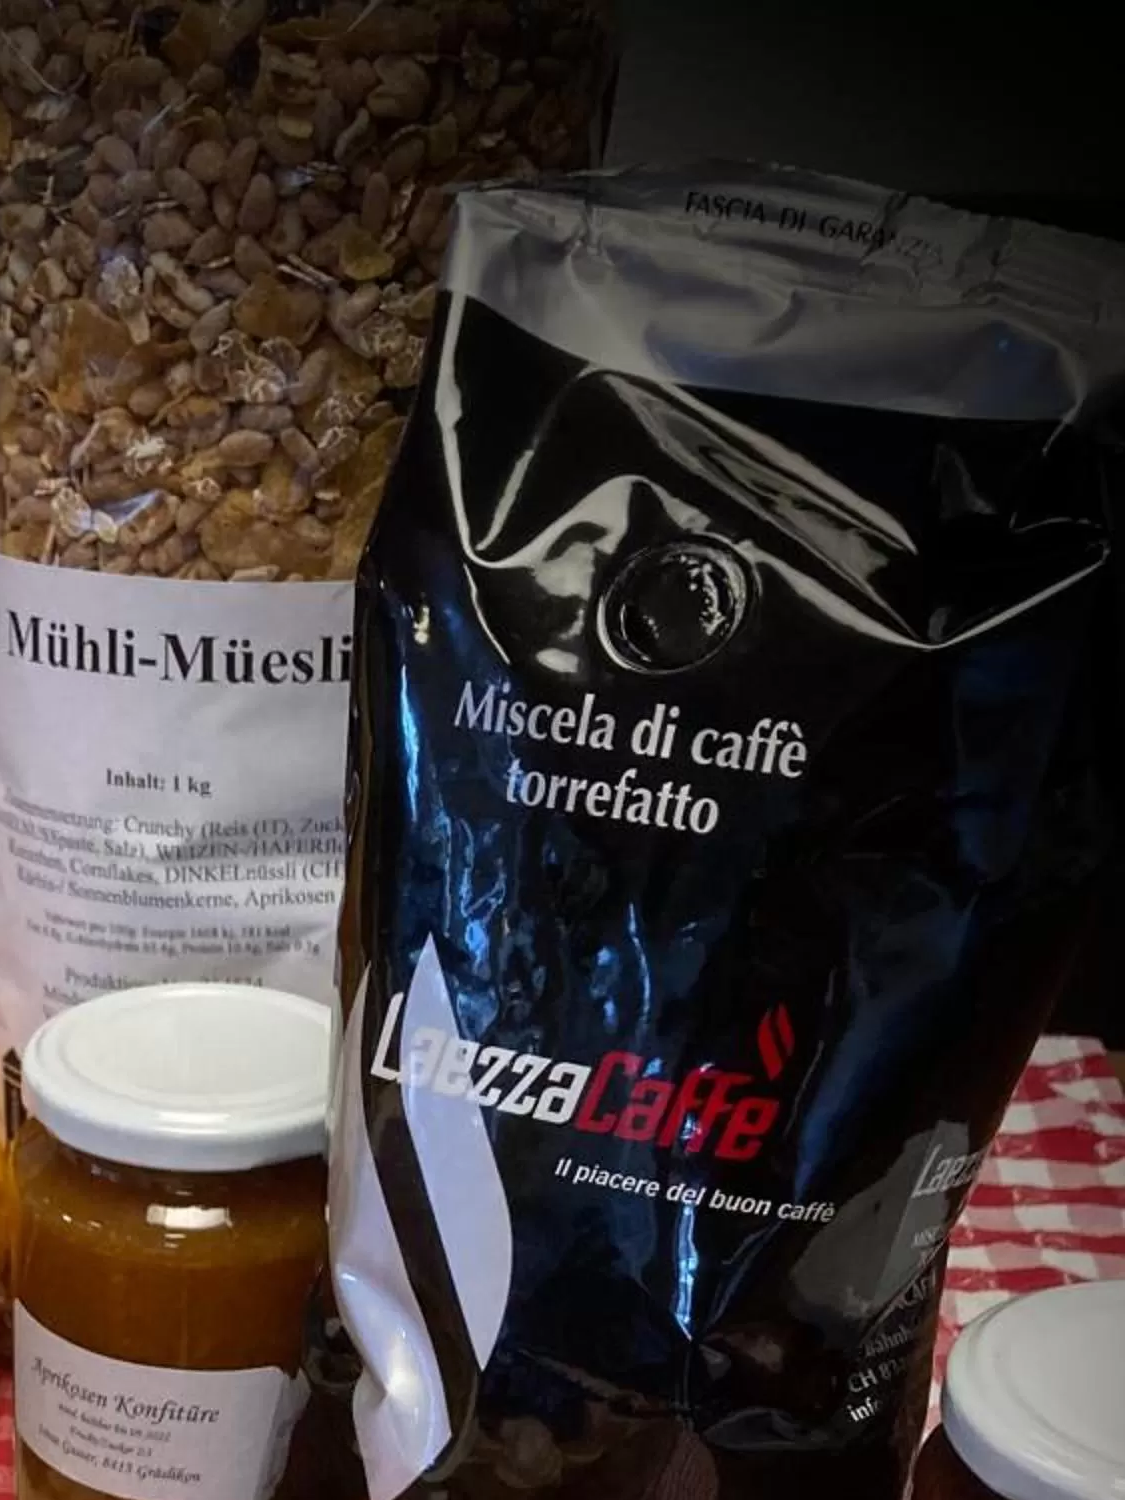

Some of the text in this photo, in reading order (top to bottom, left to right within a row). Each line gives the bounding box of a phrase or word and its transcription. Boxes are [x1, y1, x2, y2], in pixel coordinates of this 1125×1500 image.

[685, 190, 765, 224] FASCIA
[779, 206, 807, 233] DI
[6, 609, 352, 684] Mühli-Müesli
[453, 680, 808, 779] Miscela di caffè
[106, 767, 165, 793] Inhalt:
[187, 775, 212, 797] kg
[505, 758, 720, 834] torrefatto
[554, 1157, 837, 1223] Il piacere del buon caffè
[31, 1356, 221, 1425] Aprikosen Konfitüre
